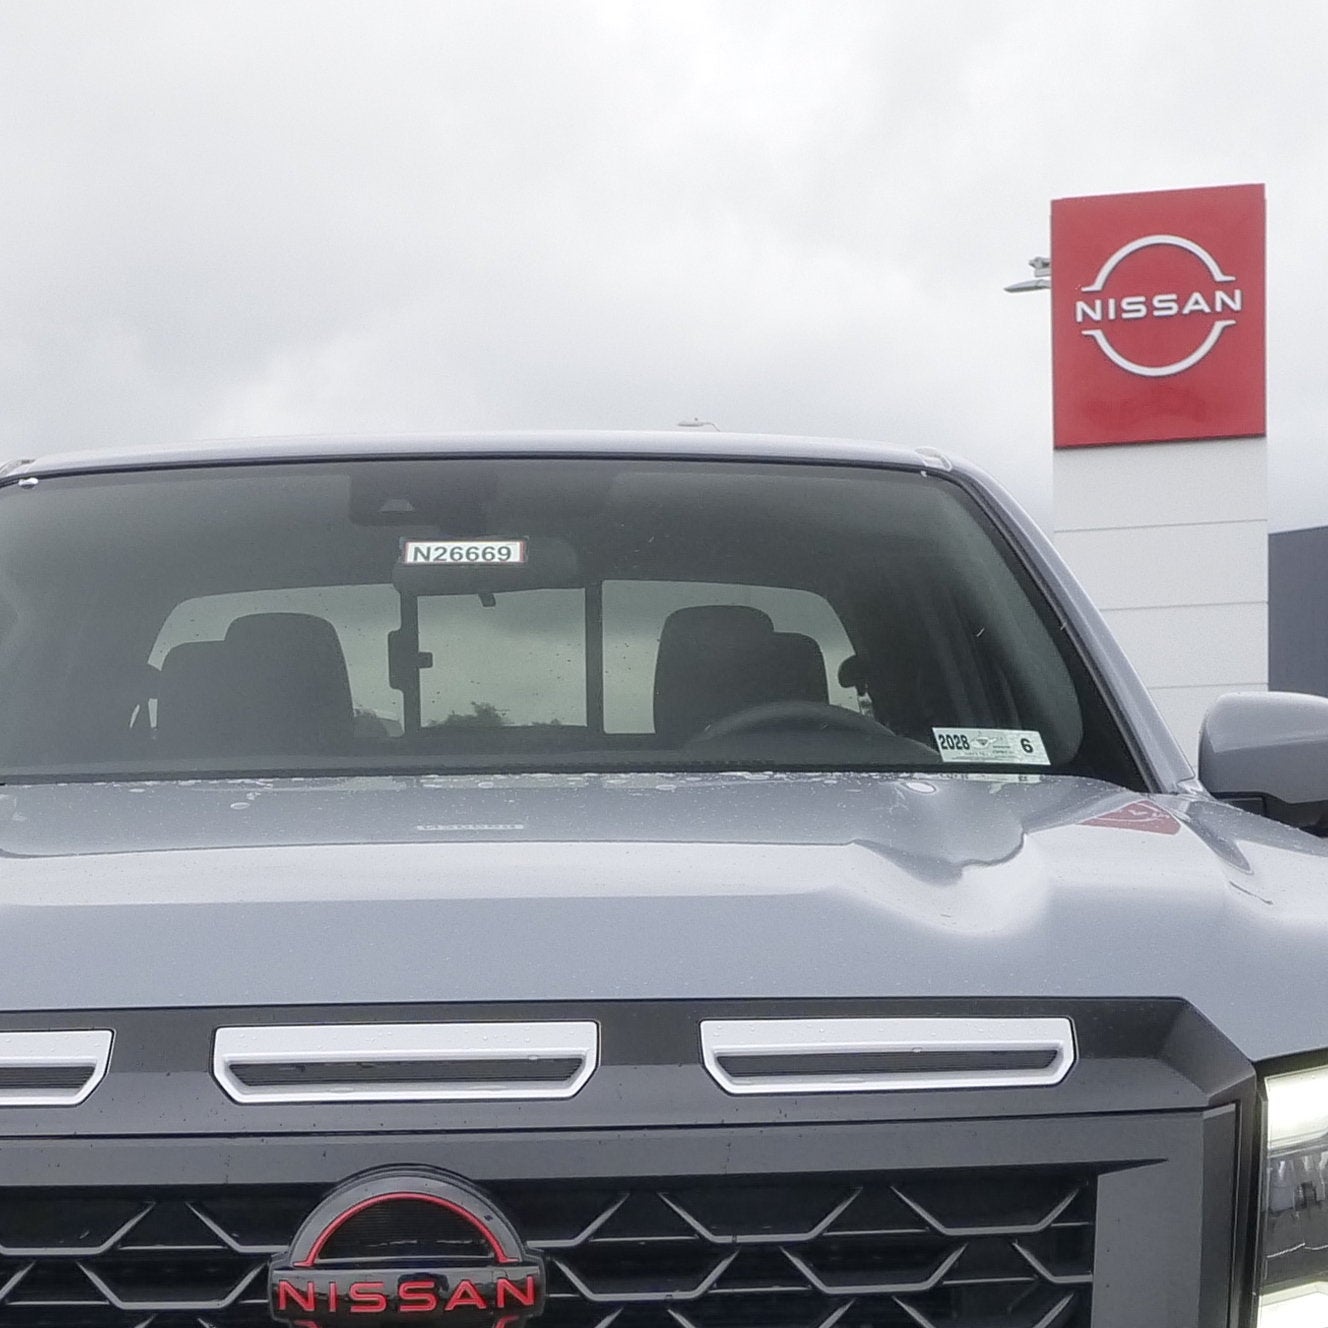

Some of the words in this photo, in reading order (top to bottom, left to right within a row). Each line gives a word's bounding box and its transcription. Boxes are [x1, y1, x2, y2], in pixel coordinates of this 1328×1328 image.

[1075, 288, 1242, 323] NISSAN
[413, 545, 512, 562] N26669
[938, 733, 971, 751] 2028
[1019, 737, 1034, 754] 6
[277, 1274, 536, 1313] NISSAN
